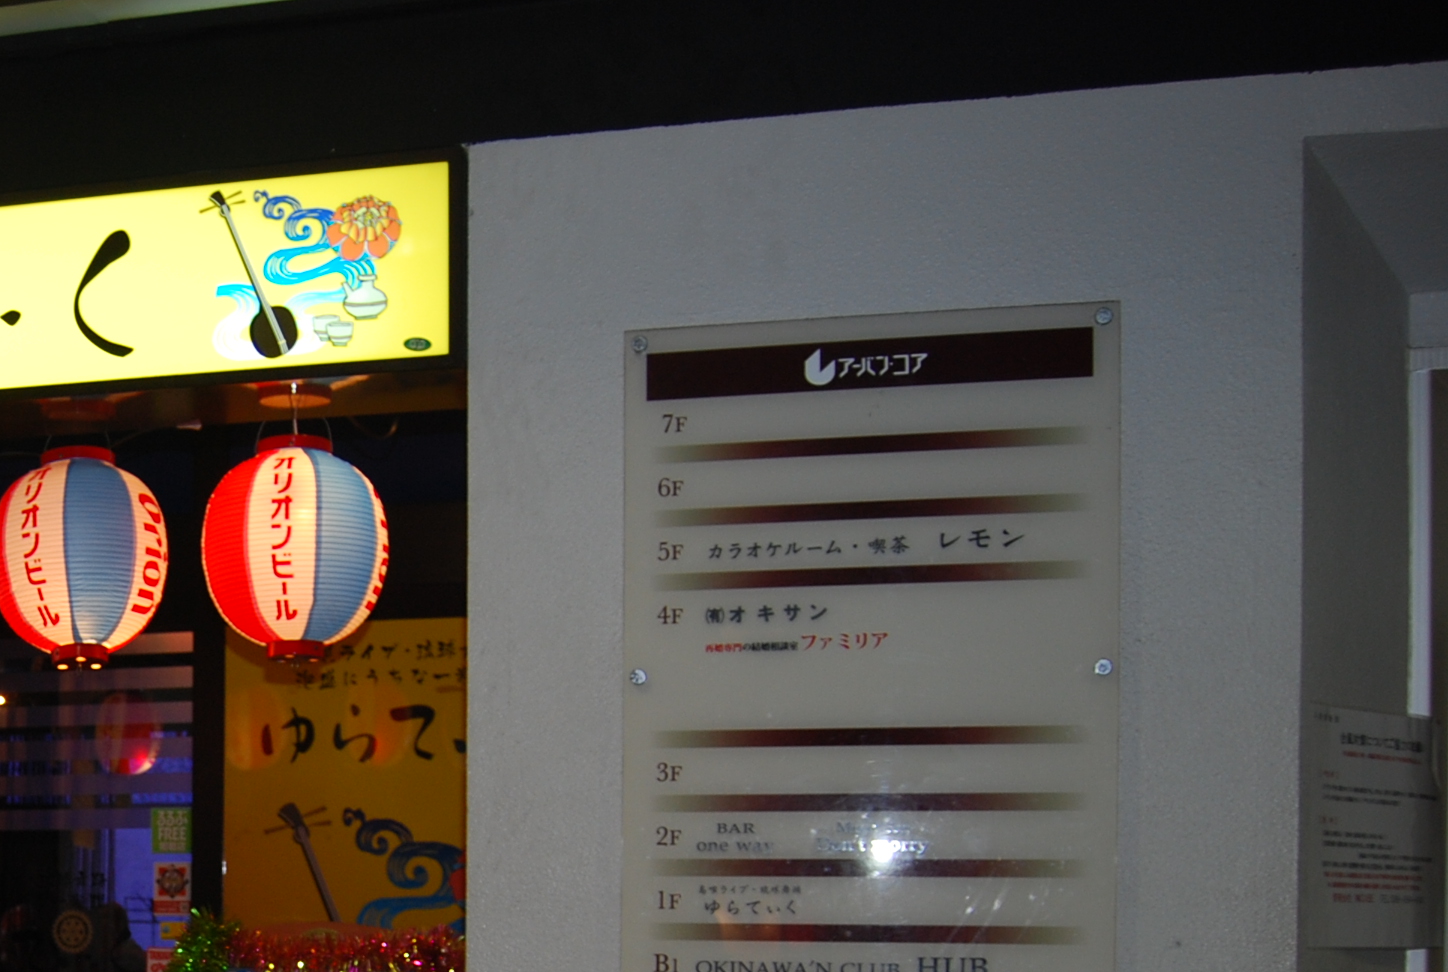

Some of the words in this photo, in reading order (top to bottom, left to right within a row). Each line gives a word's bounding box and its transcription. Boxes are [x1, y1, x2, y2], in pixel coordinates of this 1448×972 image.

[662, 414, 688, 434] 7F
[657, 477, 684, 498] 6F
[20, 467, 60, 628] オリオンビール
[270, 456, 298, 621] オリオンビール
[657, 541, 684, 561] 5F
[708, 537, 910, 560] カラオケルーム・喫茶
[940, 529, 1025, 549] レモン
[130, 492, 168, 616] Orion
[657, 606, 684, 625] 4F
[801, 632, 889, 653] ファミリア
[656, 763, 683, 782] 3F
[158, 827, 186, 841] FREE
[656, 827, 682, 846] 2F
[716, 823, 756, 834] BAR
[696, 841, 729, 852] one
[871, 840, 929, 856] orry
[657, 891, 682, 910] 1F
